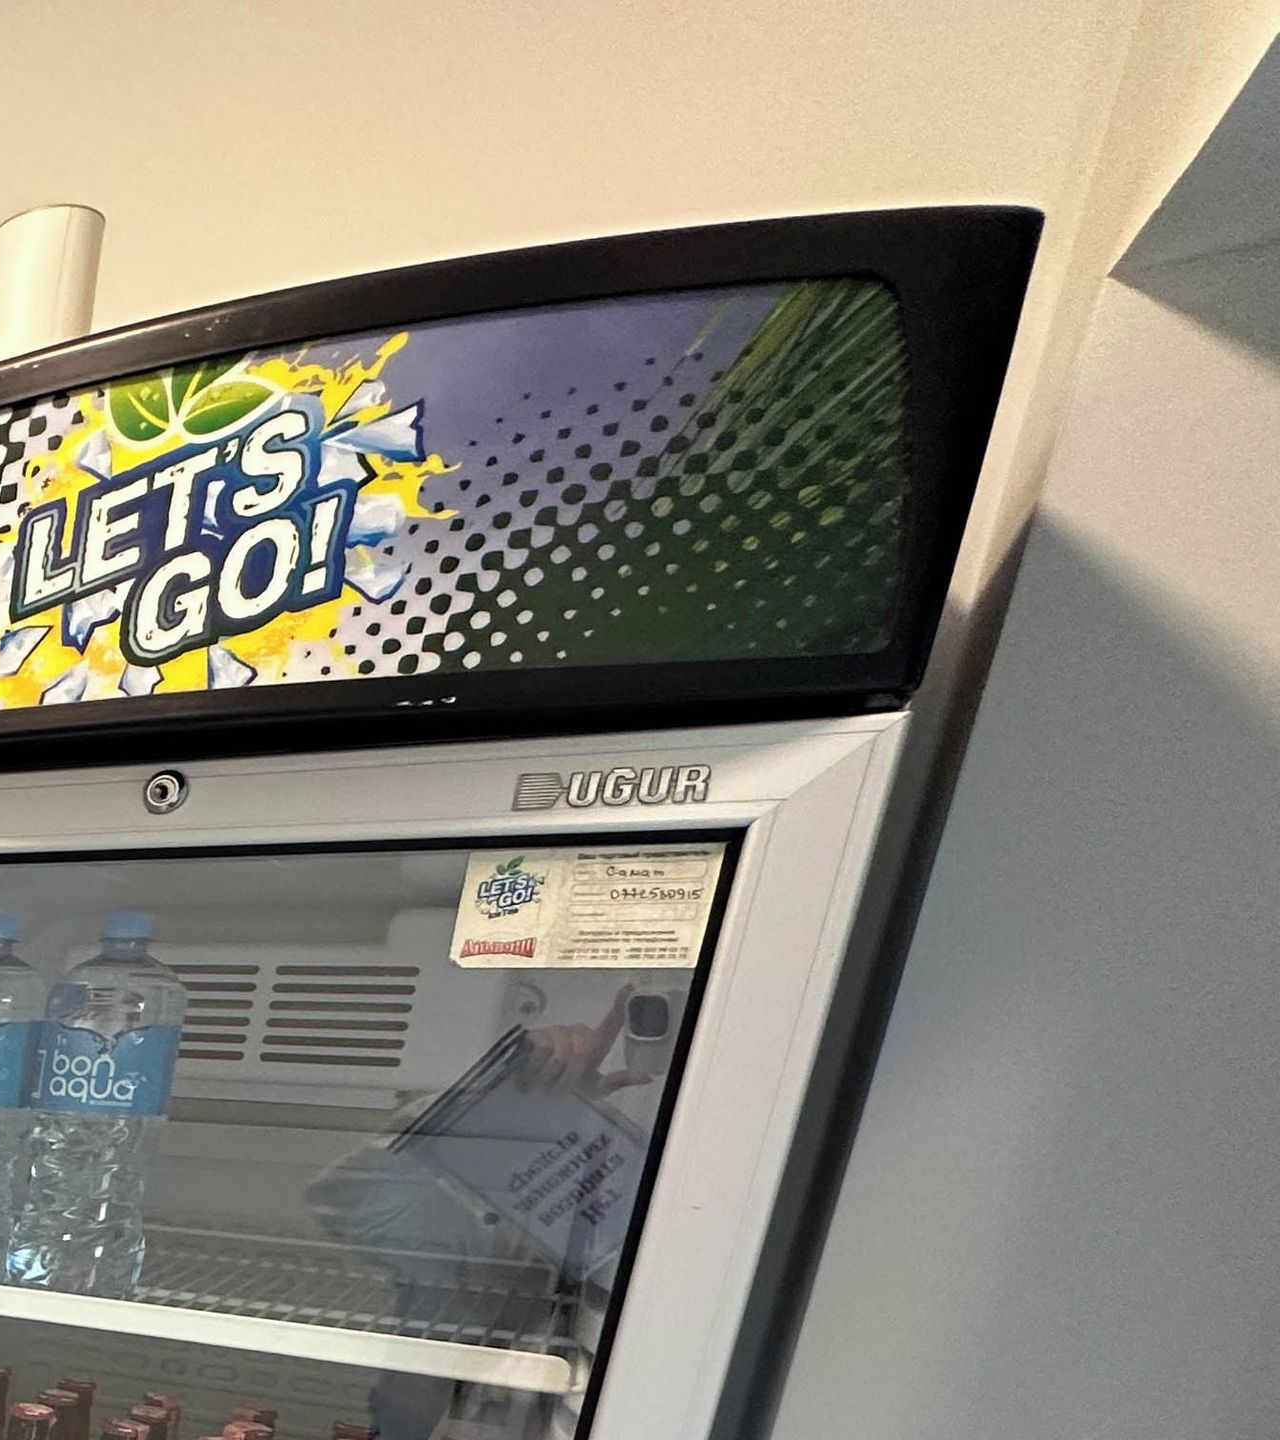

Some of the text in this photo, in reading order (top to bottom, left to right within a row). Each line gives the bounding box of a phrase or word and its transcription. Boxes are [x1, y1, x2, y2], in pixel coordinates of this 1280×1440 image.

[20, 408, 311, 609] LET'S
[137, 495, 341, 654] GO!
[567, 764, 711, 808] UGUR
[498, 887, 533, 908] GO!
[52, 1049, 116, 1078] bon
[49, 1076, 135, 1103] aqua
